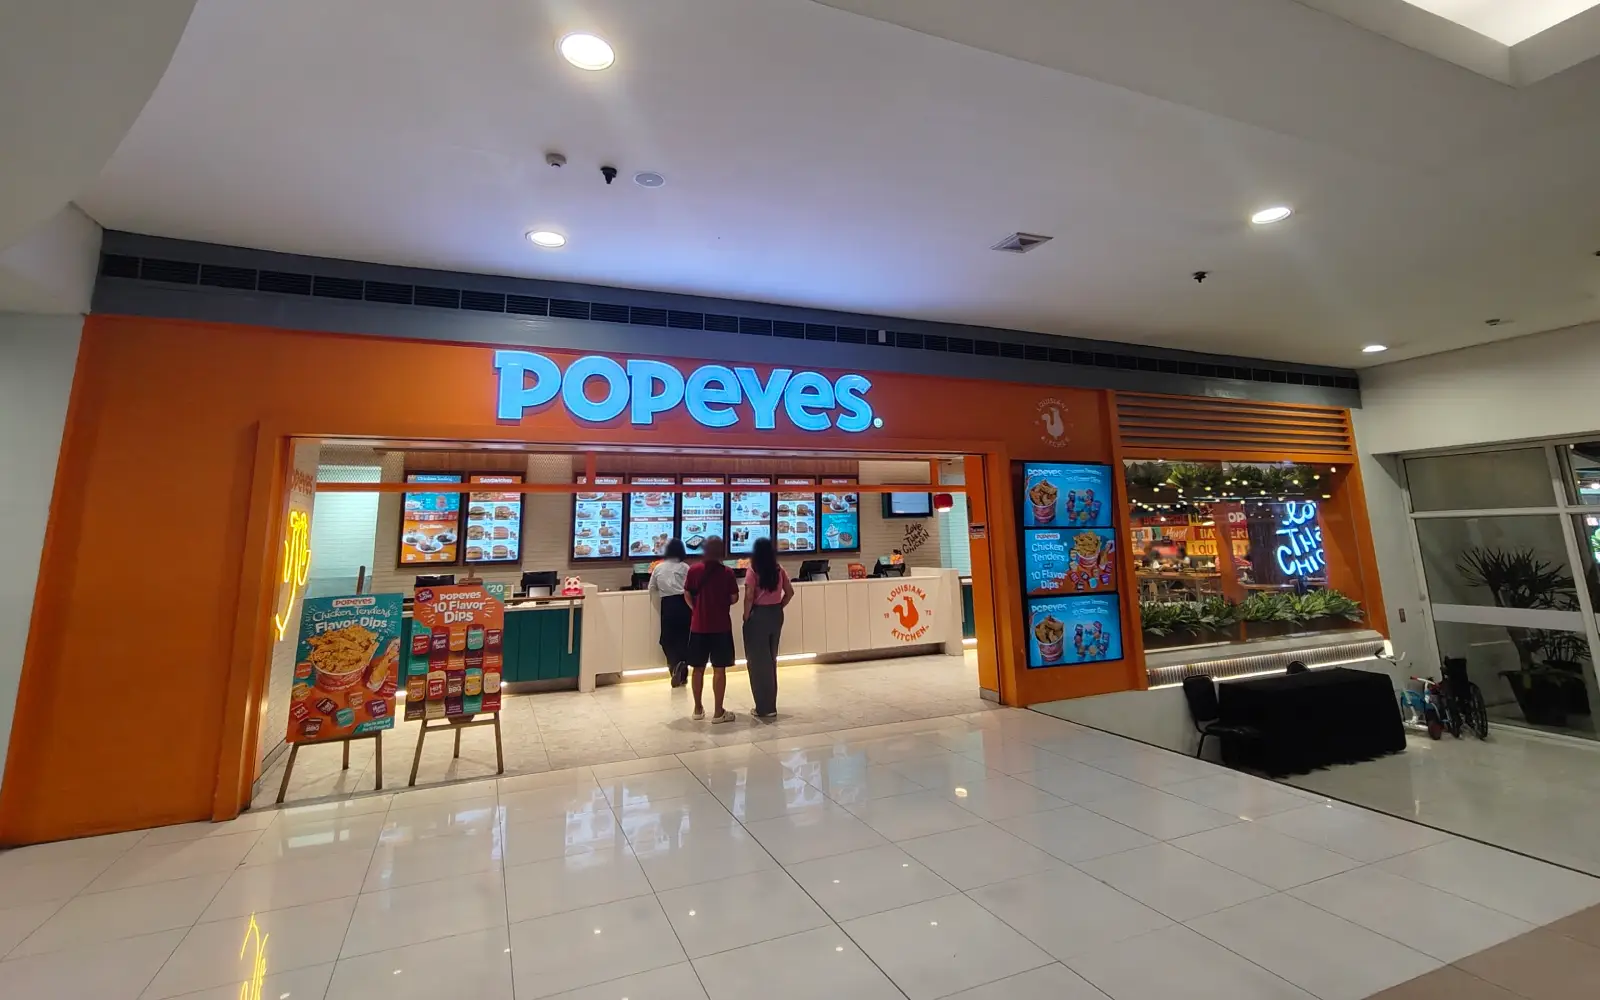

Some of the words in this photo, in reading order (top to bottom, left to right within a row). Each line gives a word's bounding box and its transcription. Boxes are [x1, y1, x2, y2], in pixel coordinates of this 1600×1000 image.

[495, 350, 875, 433] POPEYES
[1031, 542, 1064, 552] Chicken
[1032, 552, 1065, 562] Tenders
[1031, 572, 1040, 580] 10
[1042, 570, 1067, 579] Flavor
[1041, 580, 1059, 590] Dips
[440, 591, 482, 600] POPEYES
[887, 584, 926, 602] LOUISIANA
[335, 598, 372, 606] POPEYES
[433, 602, 447, 613] 10
[449, 600, 487, 611] Flavor
[313, 607, 354, 622] Chicken
[355, 605, 391, 617] Tenders
[1031, 604, 1068, 613] POPEYES
[444, 610, 474, 624] Dips
[315, 619, 358, 633] Flavor
[360, 616, 388, 629] Dips
[891, 626, 927, 642] KITCHEN
